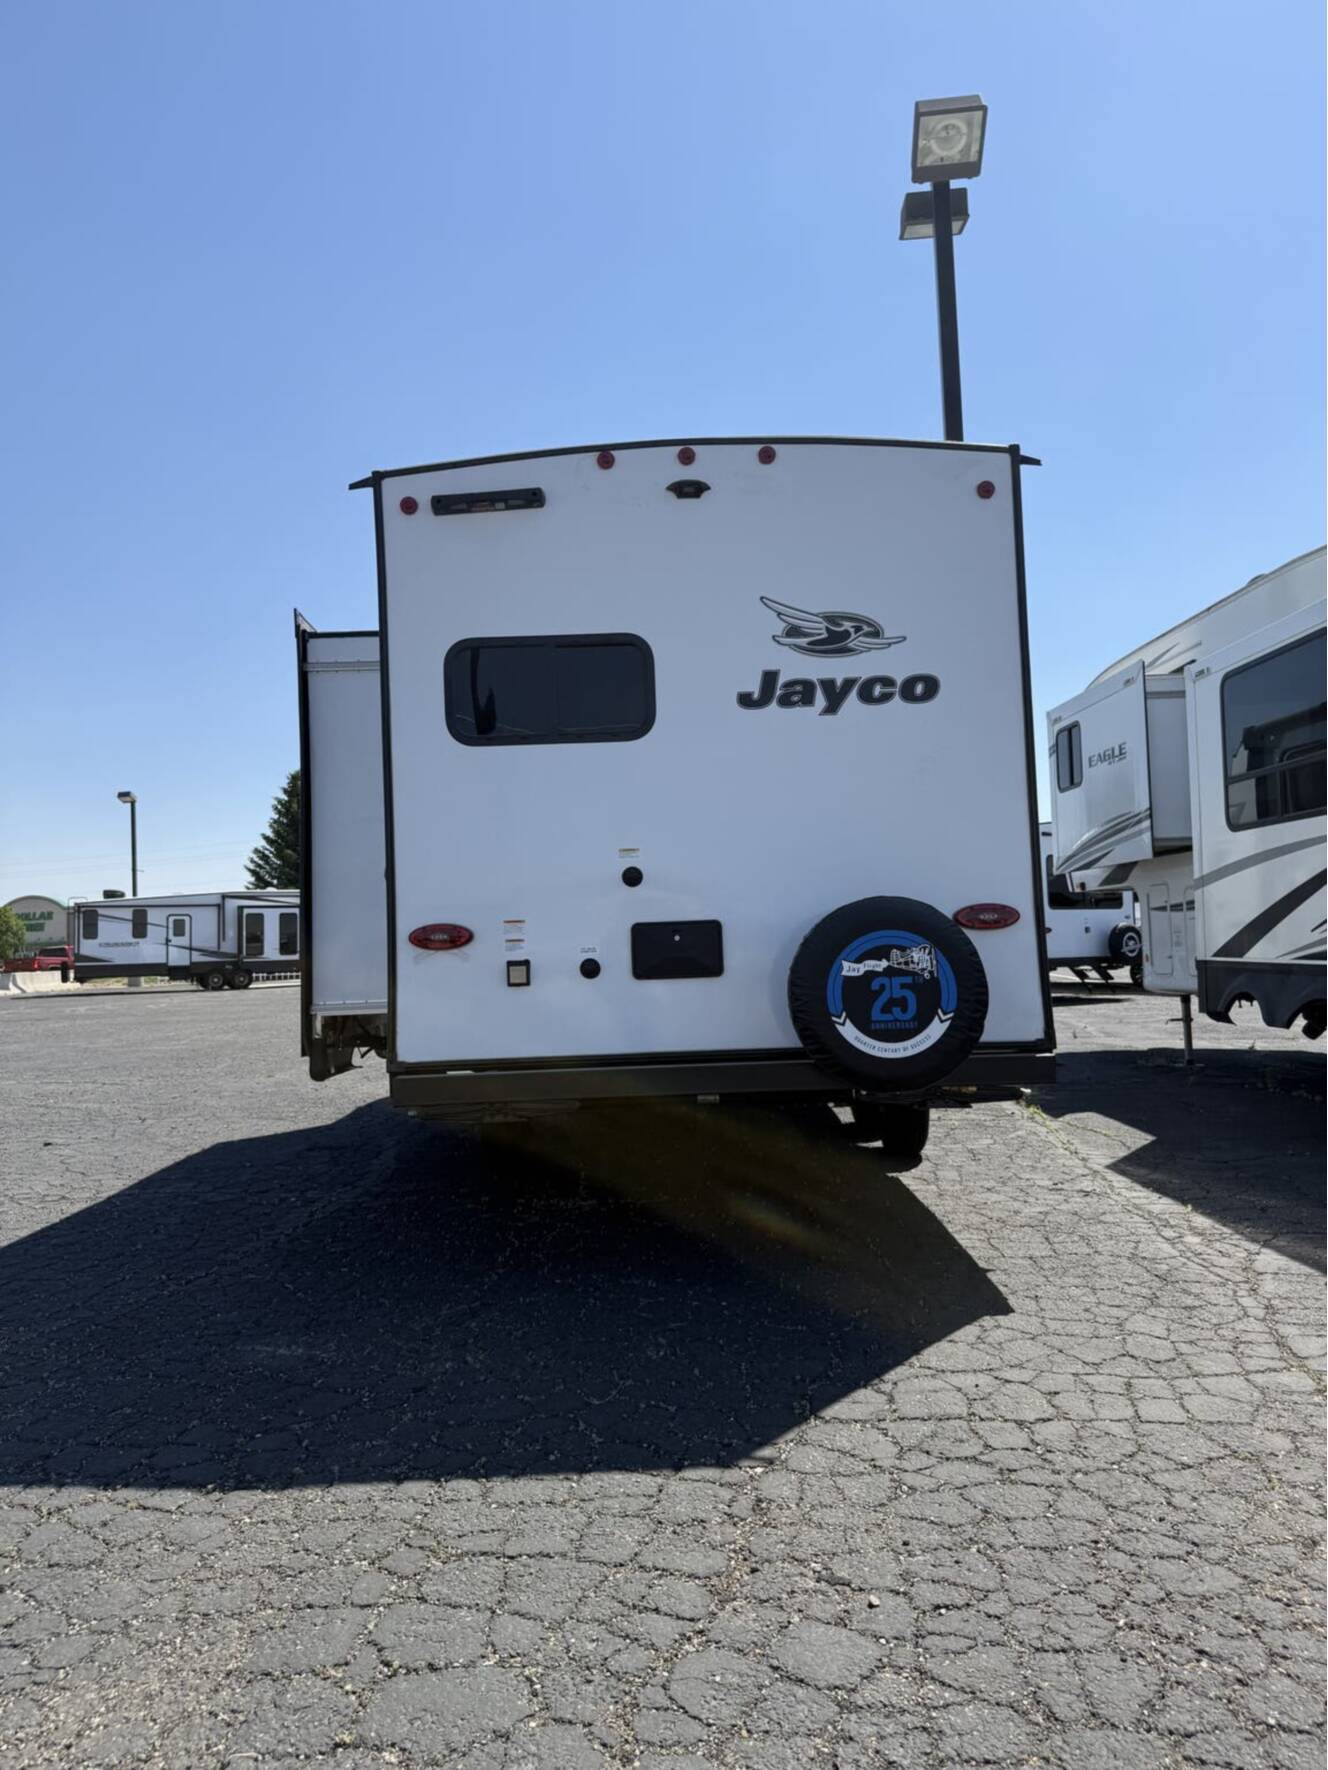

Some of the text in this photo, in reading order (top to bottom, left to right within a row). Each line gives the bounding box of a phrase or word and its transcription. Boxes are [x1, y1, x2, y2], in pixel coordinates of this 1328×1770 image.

[736, 669, 941, 716] Jayco
[1088, 741, 1127, 769] EAGLE
[871, 976, 917, 1021] 25
